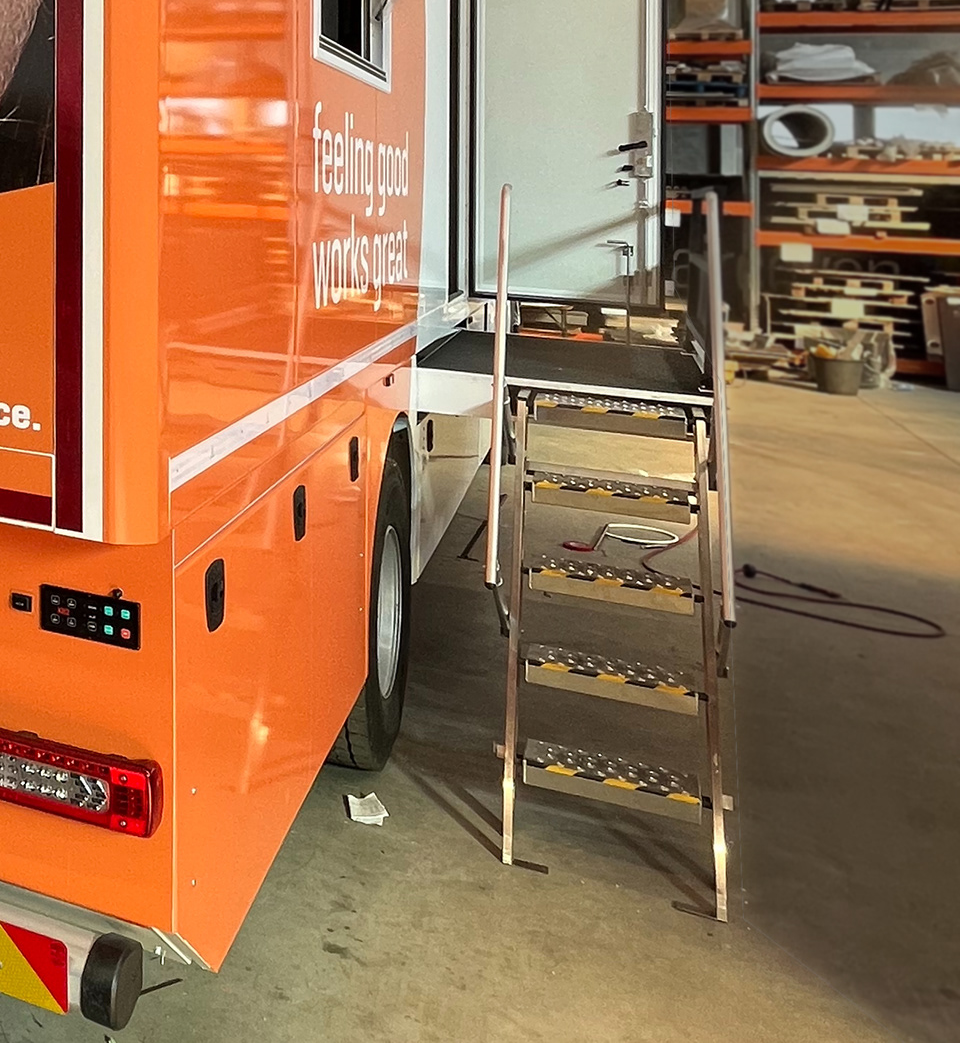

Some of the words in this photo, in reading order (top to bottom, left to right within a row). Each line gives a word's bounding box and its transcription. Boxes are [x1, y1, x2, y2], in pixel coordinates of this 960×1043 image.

[312, 101, 374, 218] feeling
[377, 131, 409, 217] good
[312, 214, 369, 310] works
[373, 219, 409, 312] great
